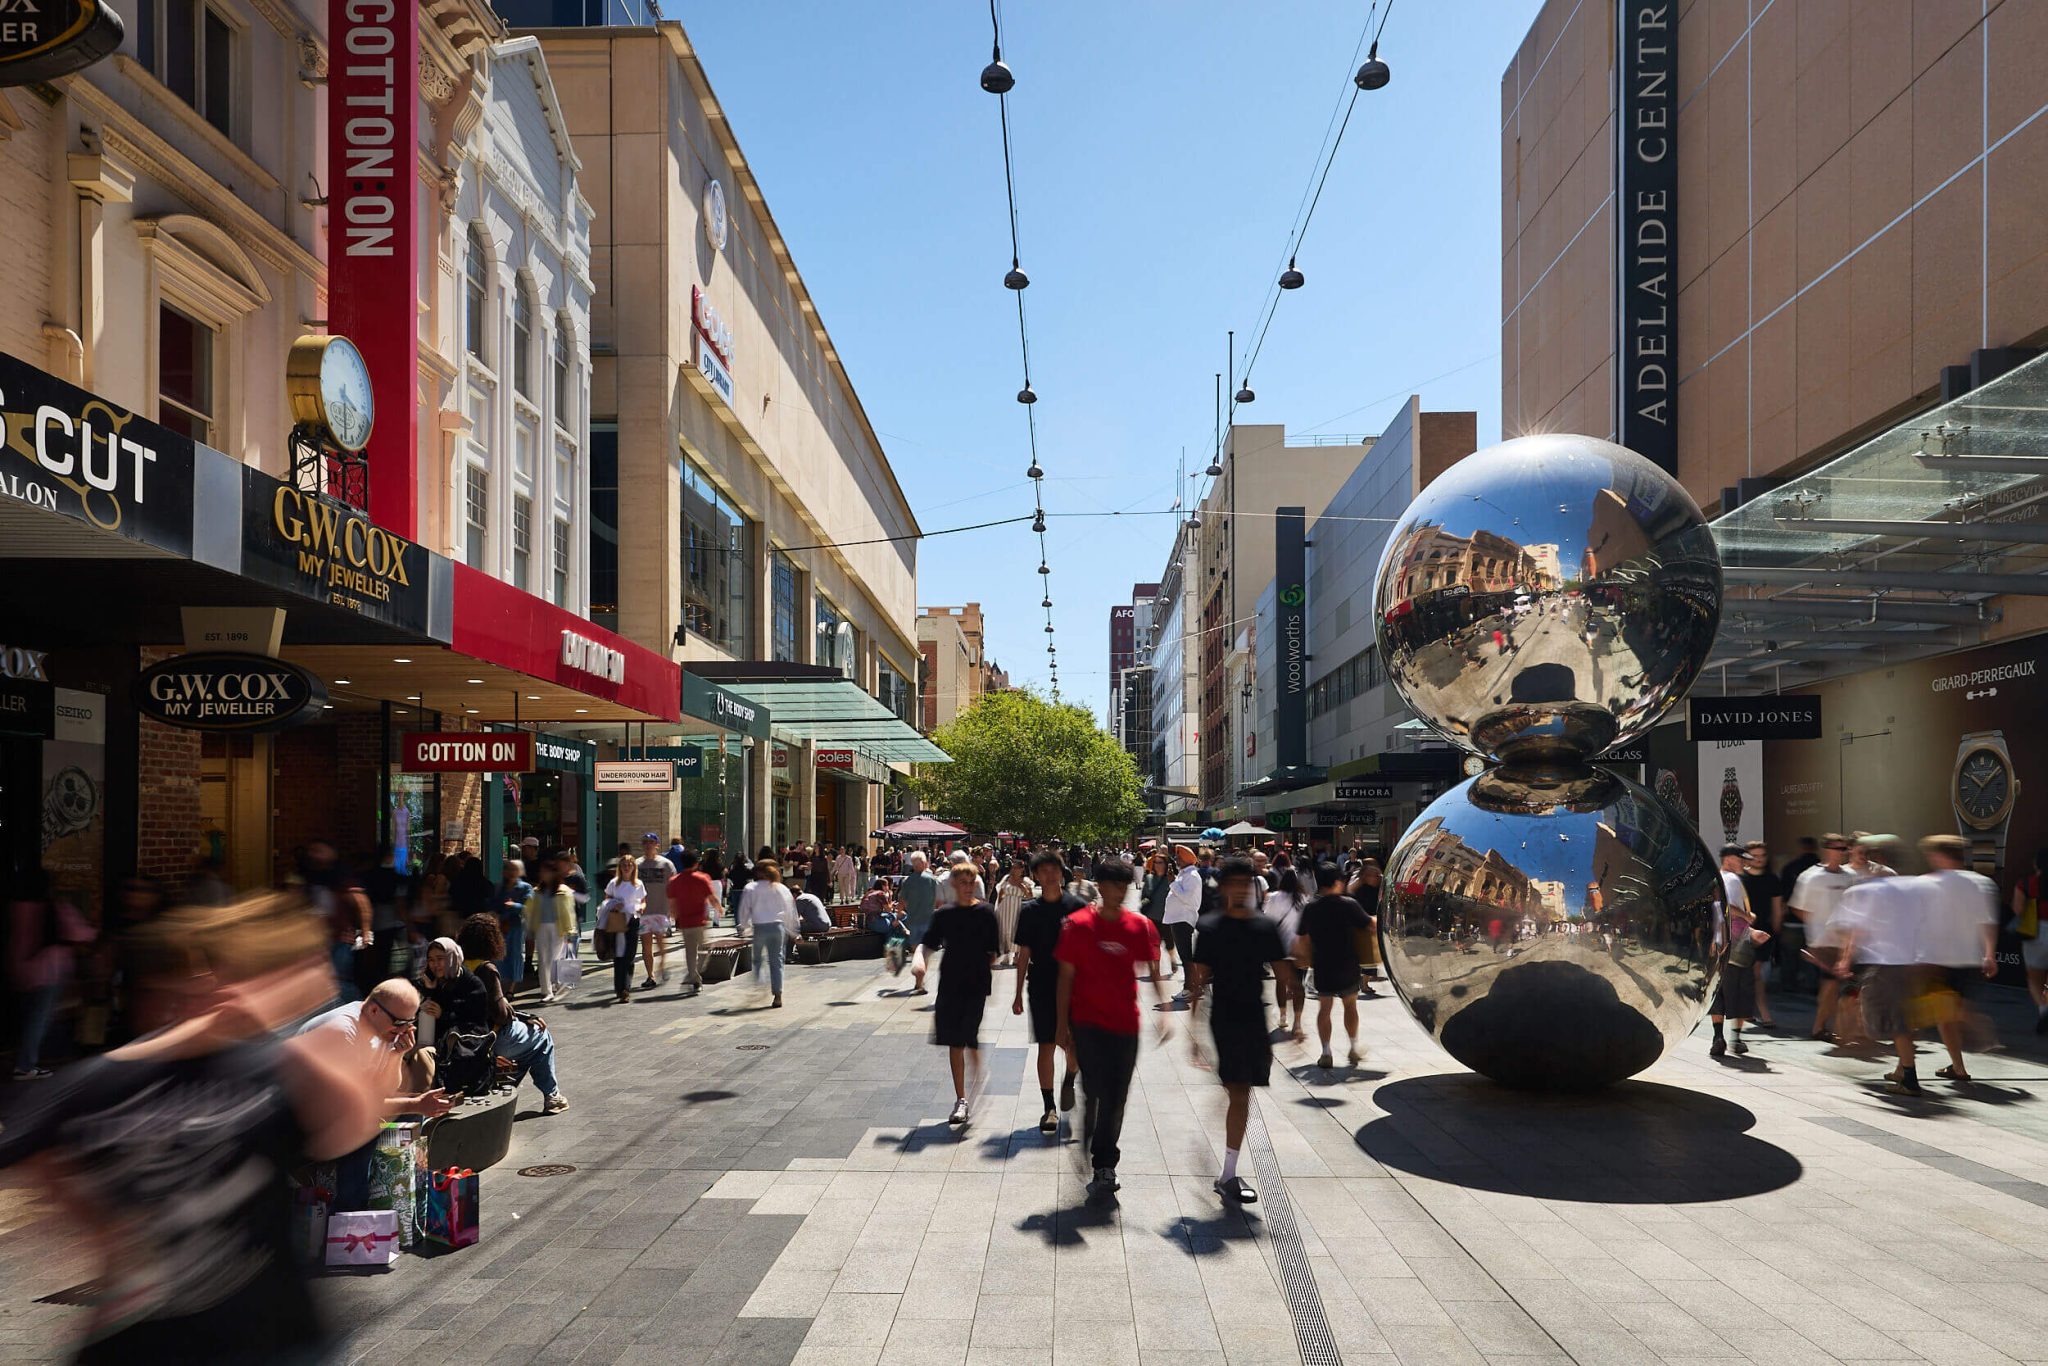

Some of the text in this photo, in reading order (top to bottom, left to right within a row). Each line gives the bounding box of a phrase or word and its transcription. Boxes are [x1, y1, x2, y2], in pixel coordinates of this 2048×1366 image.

[2, 22, 38, 42] ER
[1638, 4, 1667, 425] ADELAIDE CENTR
[36, 405, 157, 504] CUT
[274, 486, 410, 586] G.W. COX
[298, 551, 390, 602] MY JEWELLER
[205, 632, 249, 642] EST. 1898
[0, 644, 49, 682] OX
[1285, 615, 1300, 694] Woolworths
[1932, 660, 2036, 692] GIRARD-PERREGAUX
[150, 673, 291, 701] G.W. COX
[0, 694, 26, 713] LER
[56, 706, 93, 720] SEIKO
[165, 702, 275, 718] MY JEWELLER
[1701, 711, 1813, 724] DAVID JONES
[417, 742, 516, 762] COTTON ON
[536, 742, 581, 762] THE BODY SHOP
[817, 751, 851, 763] coles
[1609, 750, 1642, 761] GLASS
[1338, 788, 1391, 797] SEPHORA
